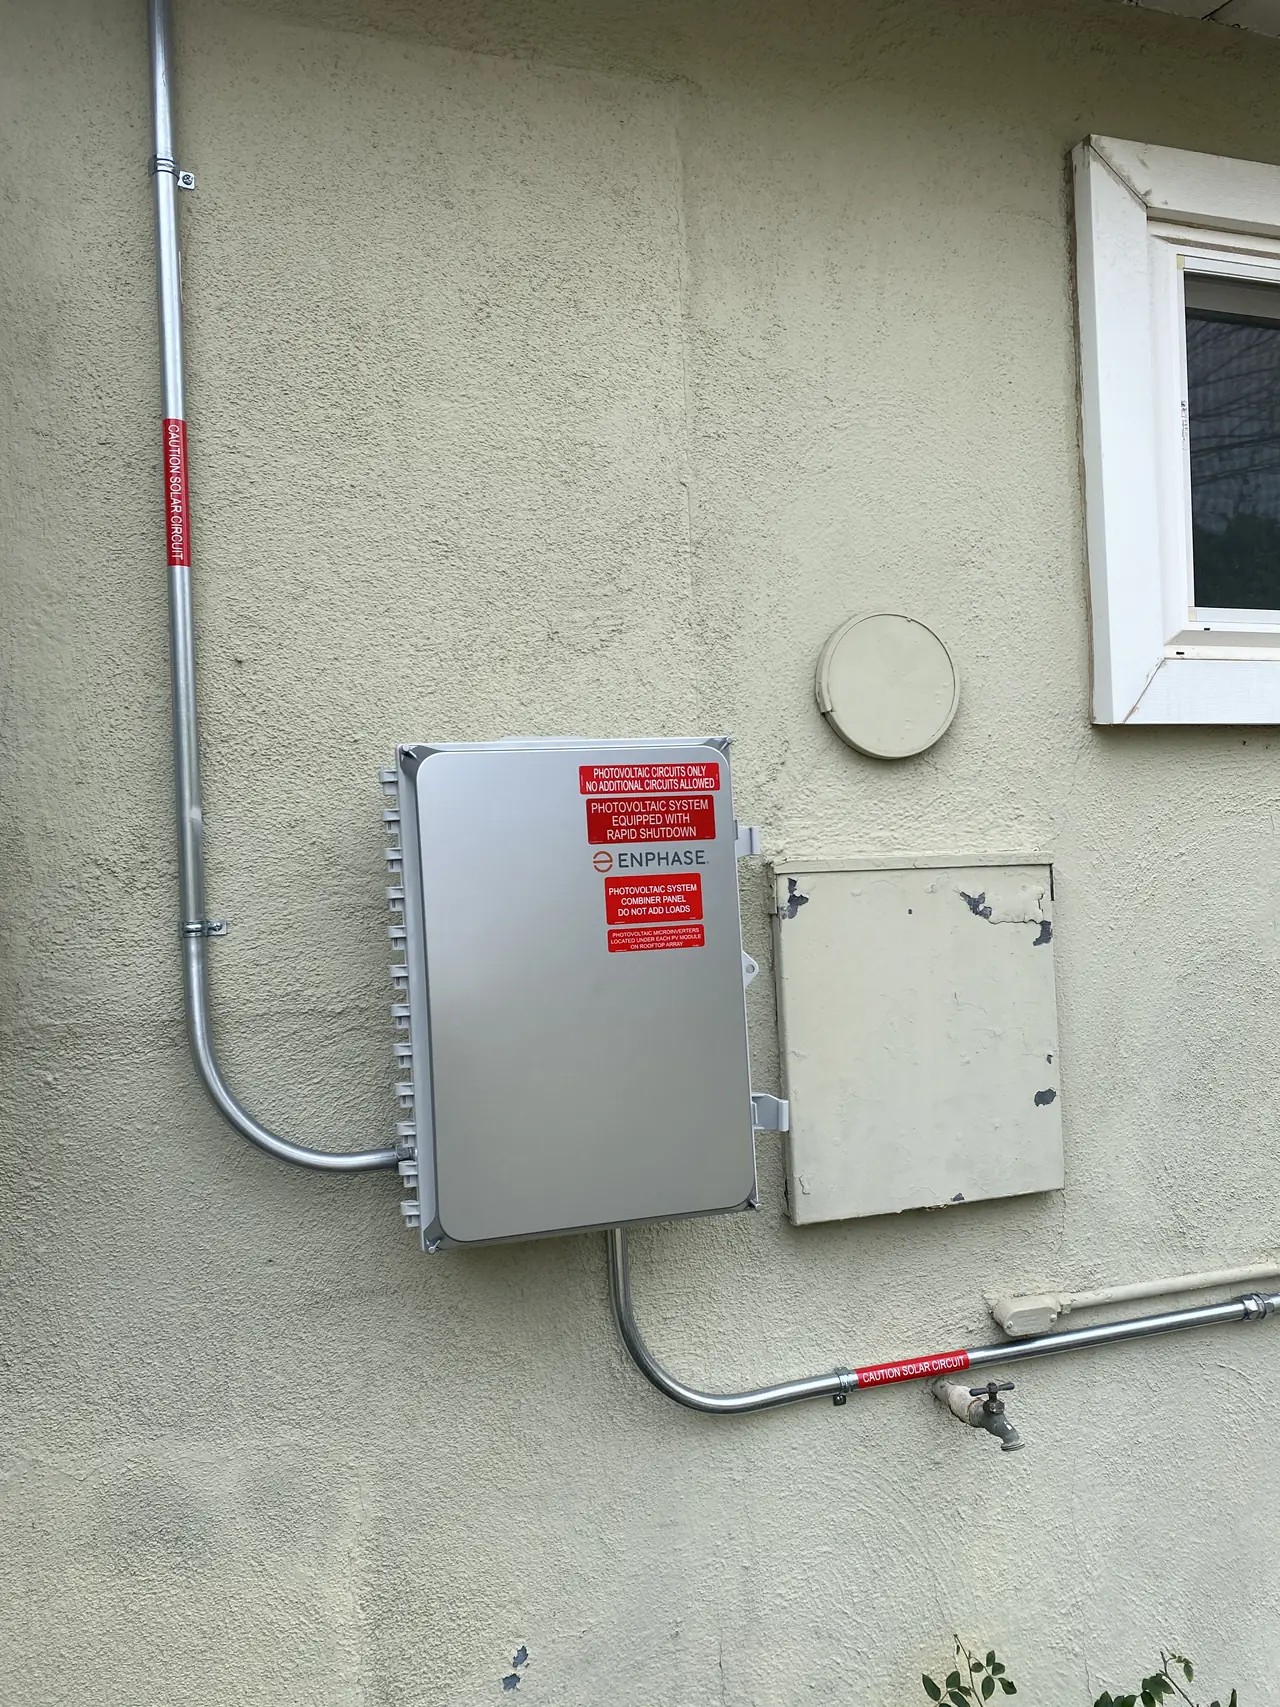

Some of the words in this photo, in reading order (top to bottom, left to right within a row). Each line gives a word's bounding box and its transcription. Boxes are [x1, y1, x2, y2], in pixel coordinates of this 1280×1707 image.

[168, 424, 181, 473] CAUTION
[170, 476, 182, 513] SOLAR
[171, 515, 184, 560] CIRCUIT
[593, 767, 650, 779] PHOTOVOLTAIC
[651, 766, 686, 777] CIRCUITS
[687, 765, 706, 776] ONLY
[586, 781, 598, 792] NO
[599, 780, 643, 791] ADDITIONAL
[644, 779, 679, 790] CIRCUITS
[680, 778, 715, 789] ALLOWED
[591, 801, 667, 813] PHOTOVOLTAIC
[669, 799, 709, 811] SYSTEM
[612, 814, 663, 827] EQUIPPED
[665, 813, 690, 825] WITH
[607, 829, 637, 840] RAPID
[640, 827, 697, 839] SHUTDOWN
[618, 850, 706, 868] ENPHASE
[608, 886, 666, 895] PHOTOVOLTAIC
[667, 884, 697, 892] SYSTEM
[621, 896, 662, 906] COMBINER
[663, 895, 686, 903] PANEL
[618, 908, 630, 916] DO
[631, 907, 647, 915] NOT
[648, 906, 665, 914] ADD
[665, 905, 690, 913] LOADS
[862, 1367, 901, 1383] CAUTION
[902, 1362, 931, 1376] SOLAR
[931, 1356, 965, 1371] CIRCUIT
